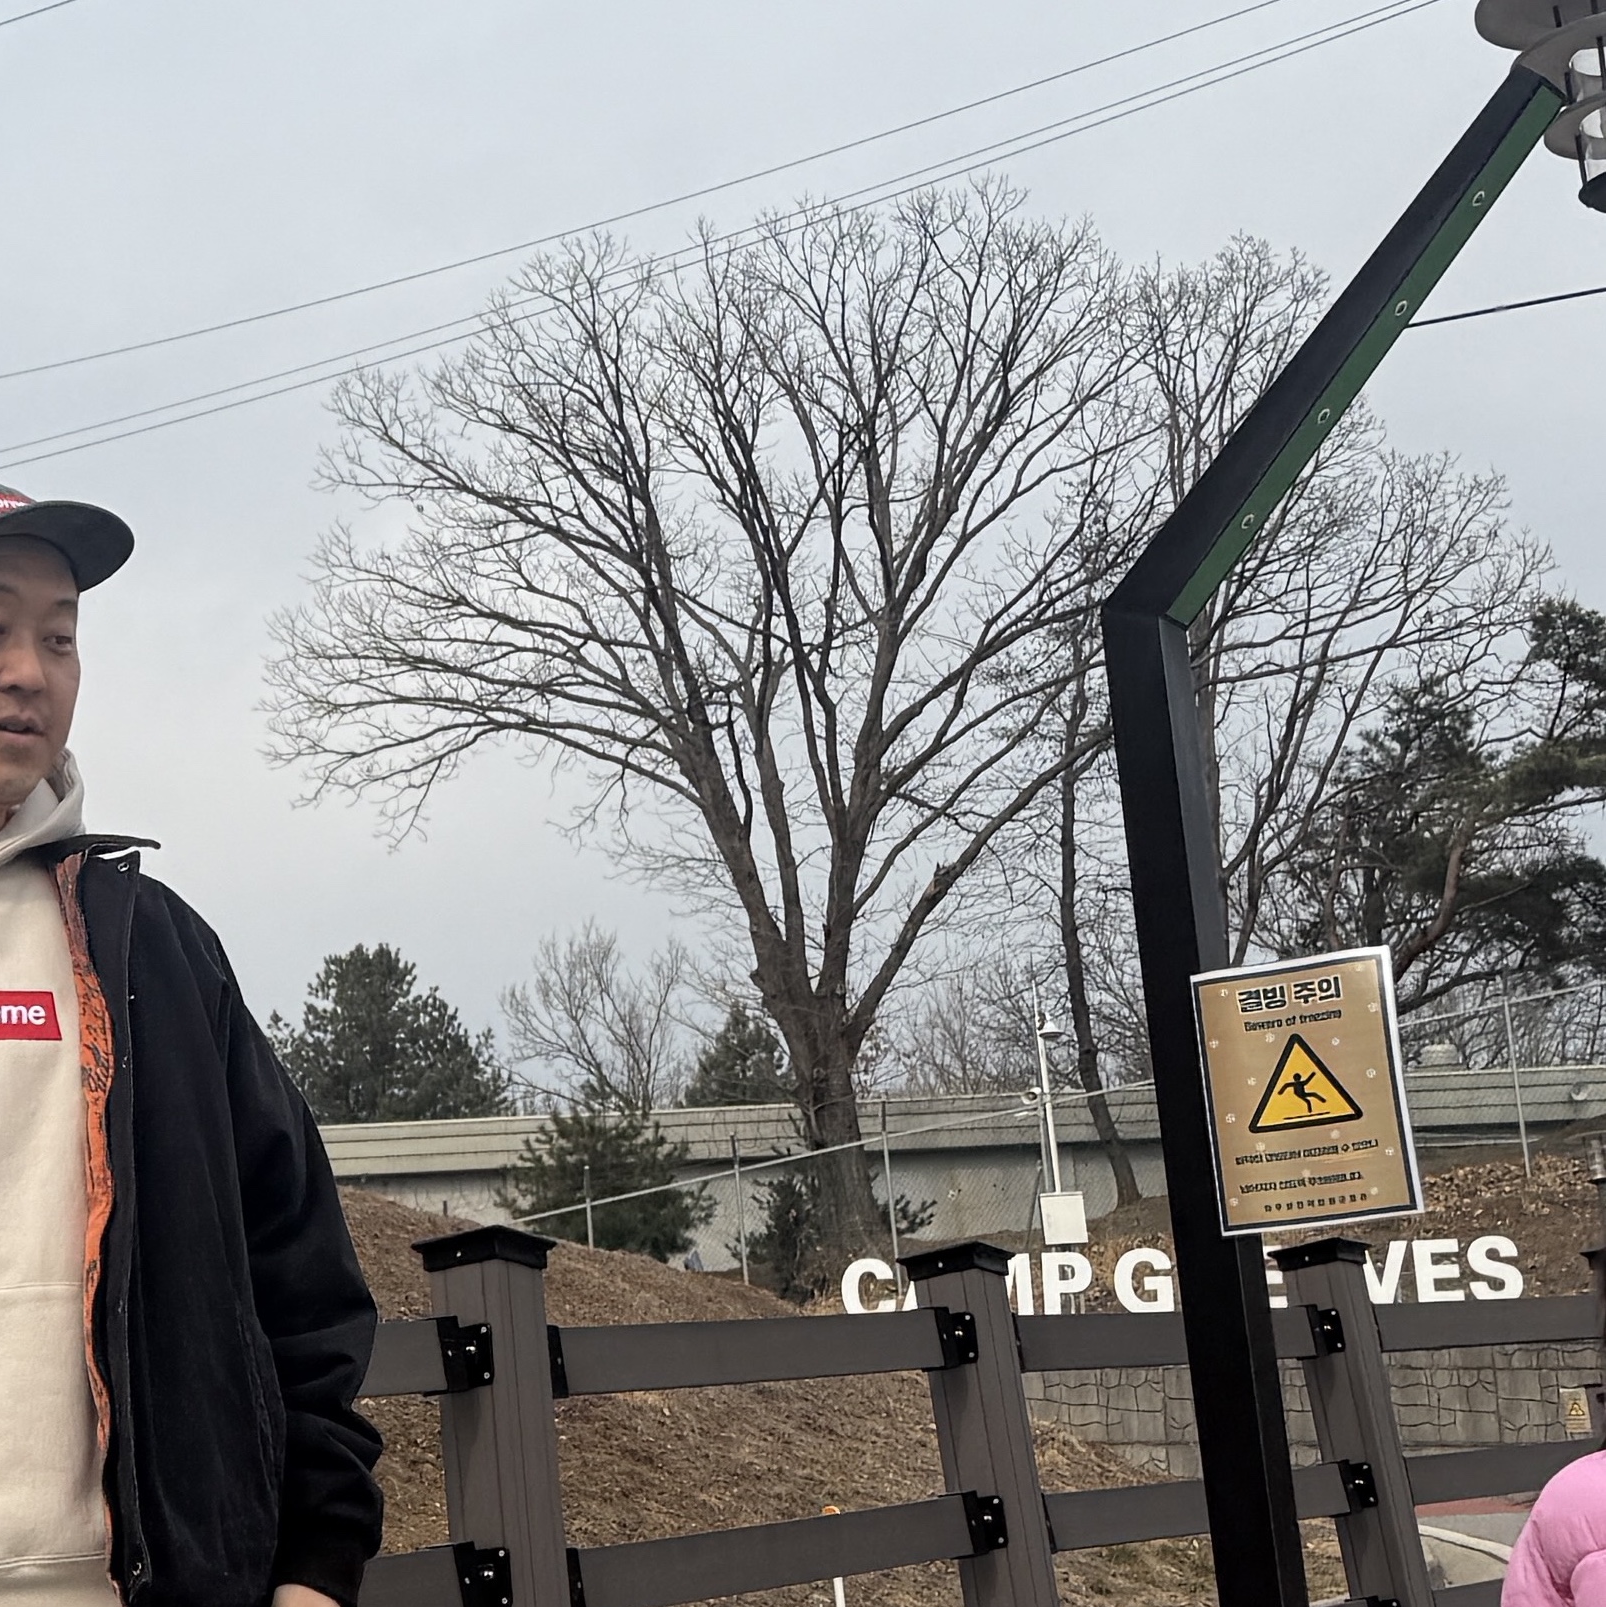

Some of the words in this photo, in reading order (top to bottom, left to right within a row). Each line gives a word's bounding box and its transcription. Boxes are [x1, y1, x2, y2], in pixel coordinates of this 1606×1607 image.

[1237, 984, 1287, 1013] 결빙
[1292, 976, 1341, 1004] 주의
[1113, 1235, 1524, 1314] GVES
